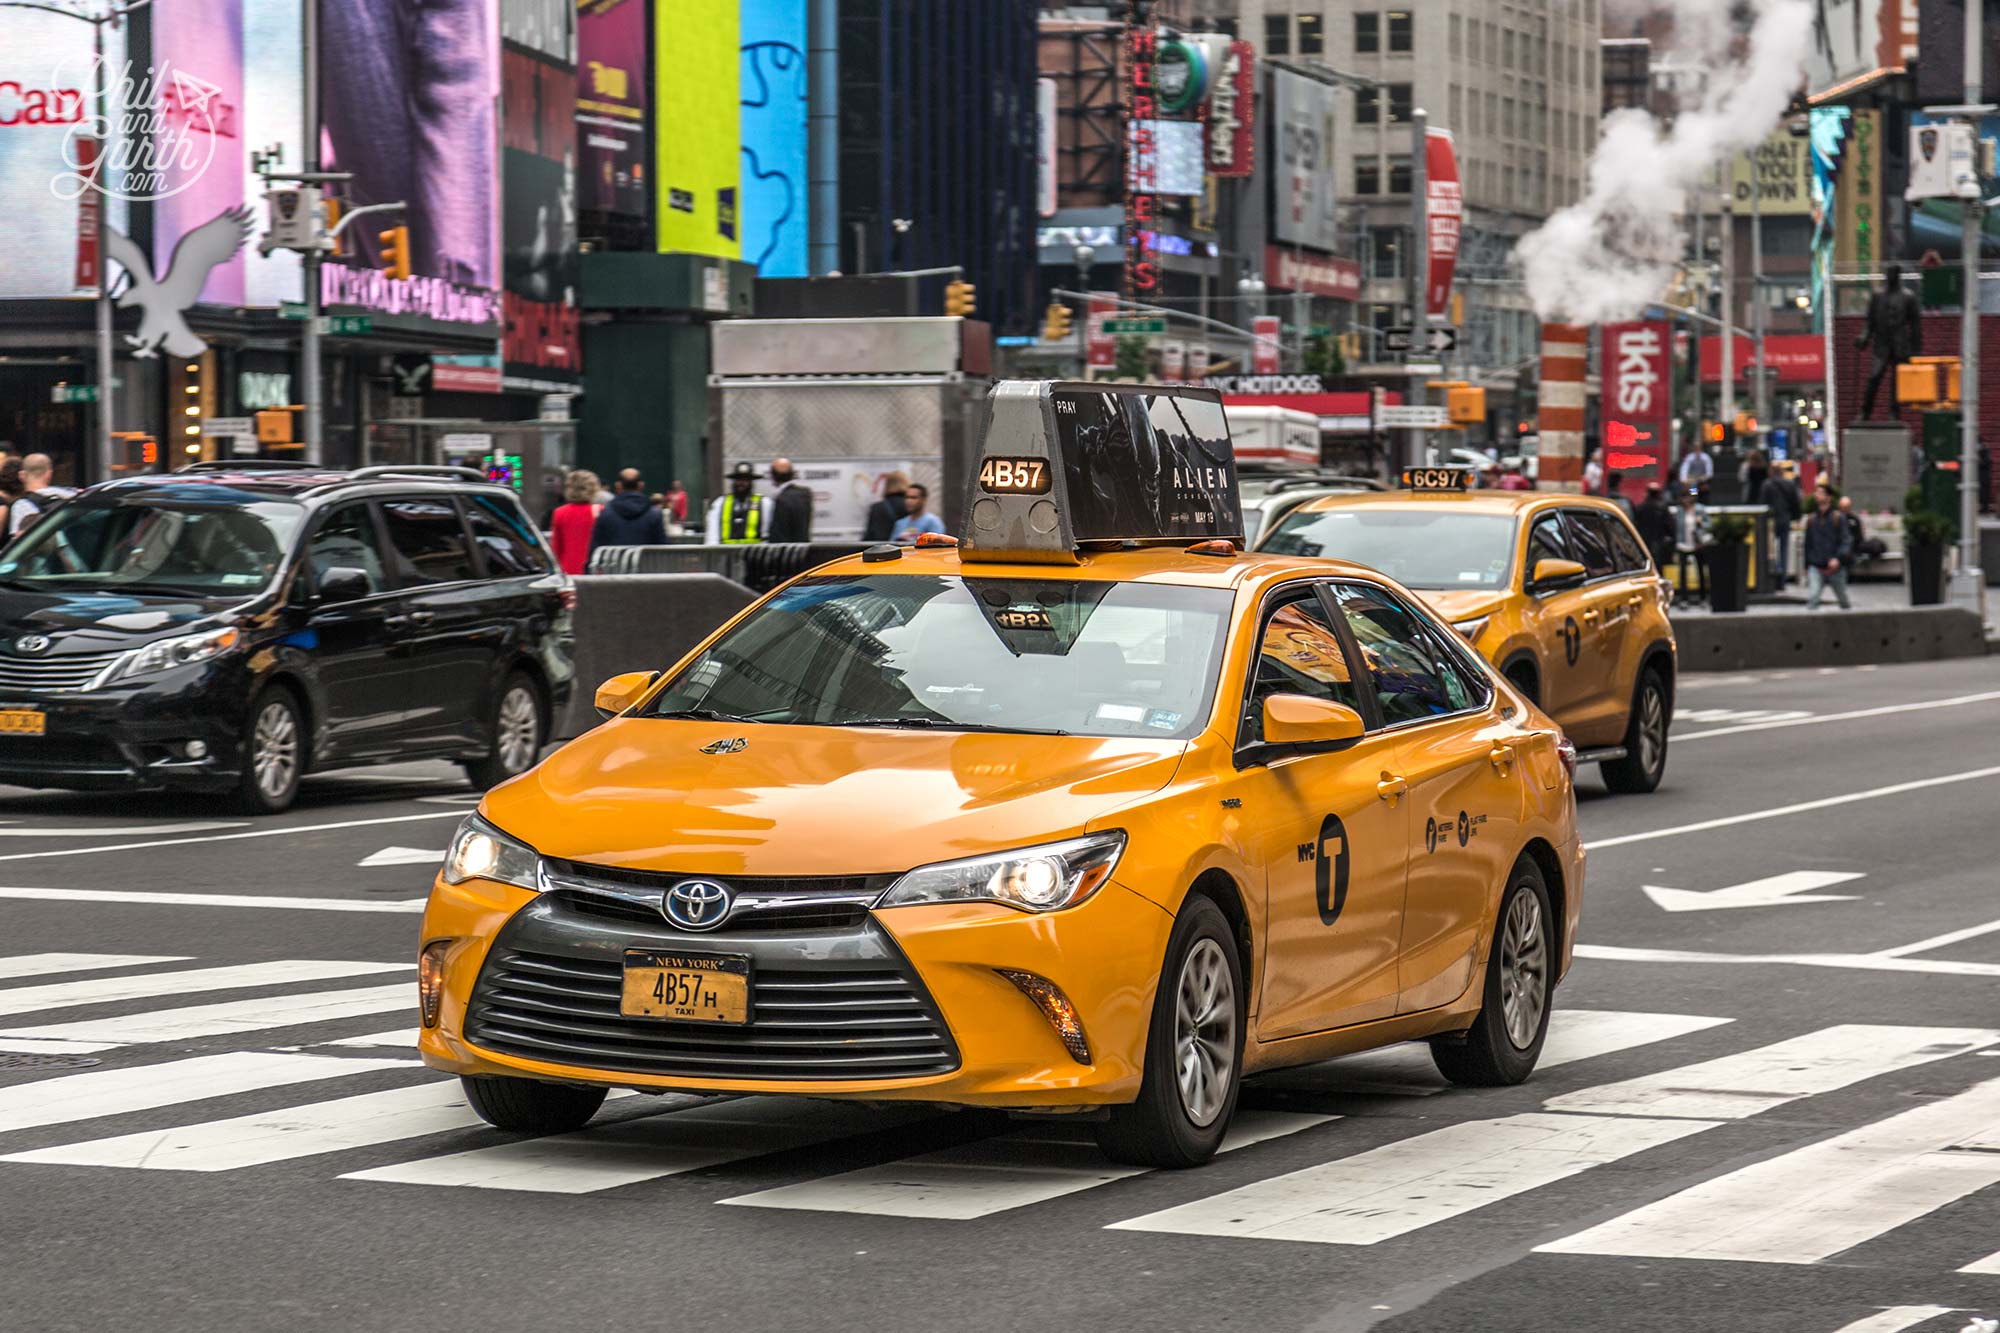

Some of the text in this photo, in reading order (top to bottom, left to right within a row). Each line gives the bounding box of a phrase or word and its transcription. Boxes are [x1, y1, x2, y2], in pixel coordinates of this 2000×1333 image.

[0, 80, 88, 128] Can
[1616, 328, 1661, 413] tkts
[1056, 400, 1077, 415] PRAY
[979, 460, 1044, 489] 4B57
[1173, 467, 1228, 489] ALIEN
[1414, 470, 1459, 487] 6C97
[1297, 842, 1315, 862] NYC
[1323, 836, 1342, 910] T
[656, 956, 719, 970] NEW YORK
[675, 1007, 695, 1016] TAXI
